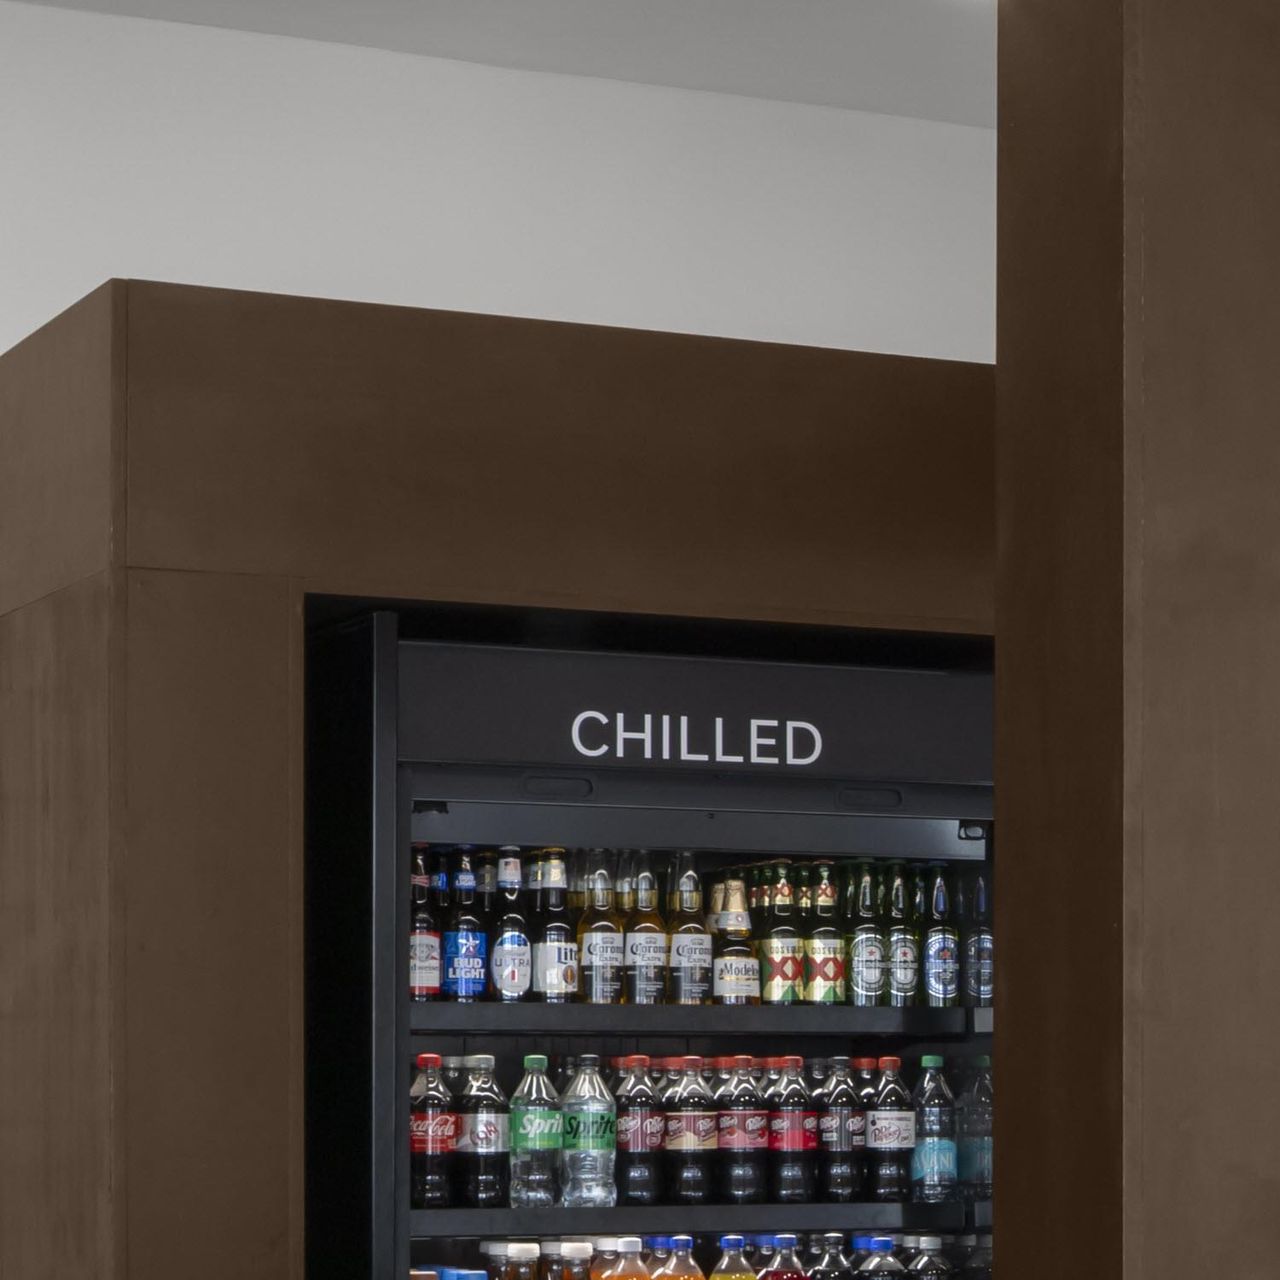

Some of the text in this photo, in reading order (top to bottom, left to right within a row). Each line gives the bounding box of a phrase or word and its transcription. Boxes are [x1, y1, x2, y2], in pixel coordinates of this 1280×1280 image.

[571, 709, 823, 765] CHILLED
[453, 957, 482, 969] BUD
[494, 957, 530, 968] ULTRA
[448, 968, 486, 980] LIGHT
